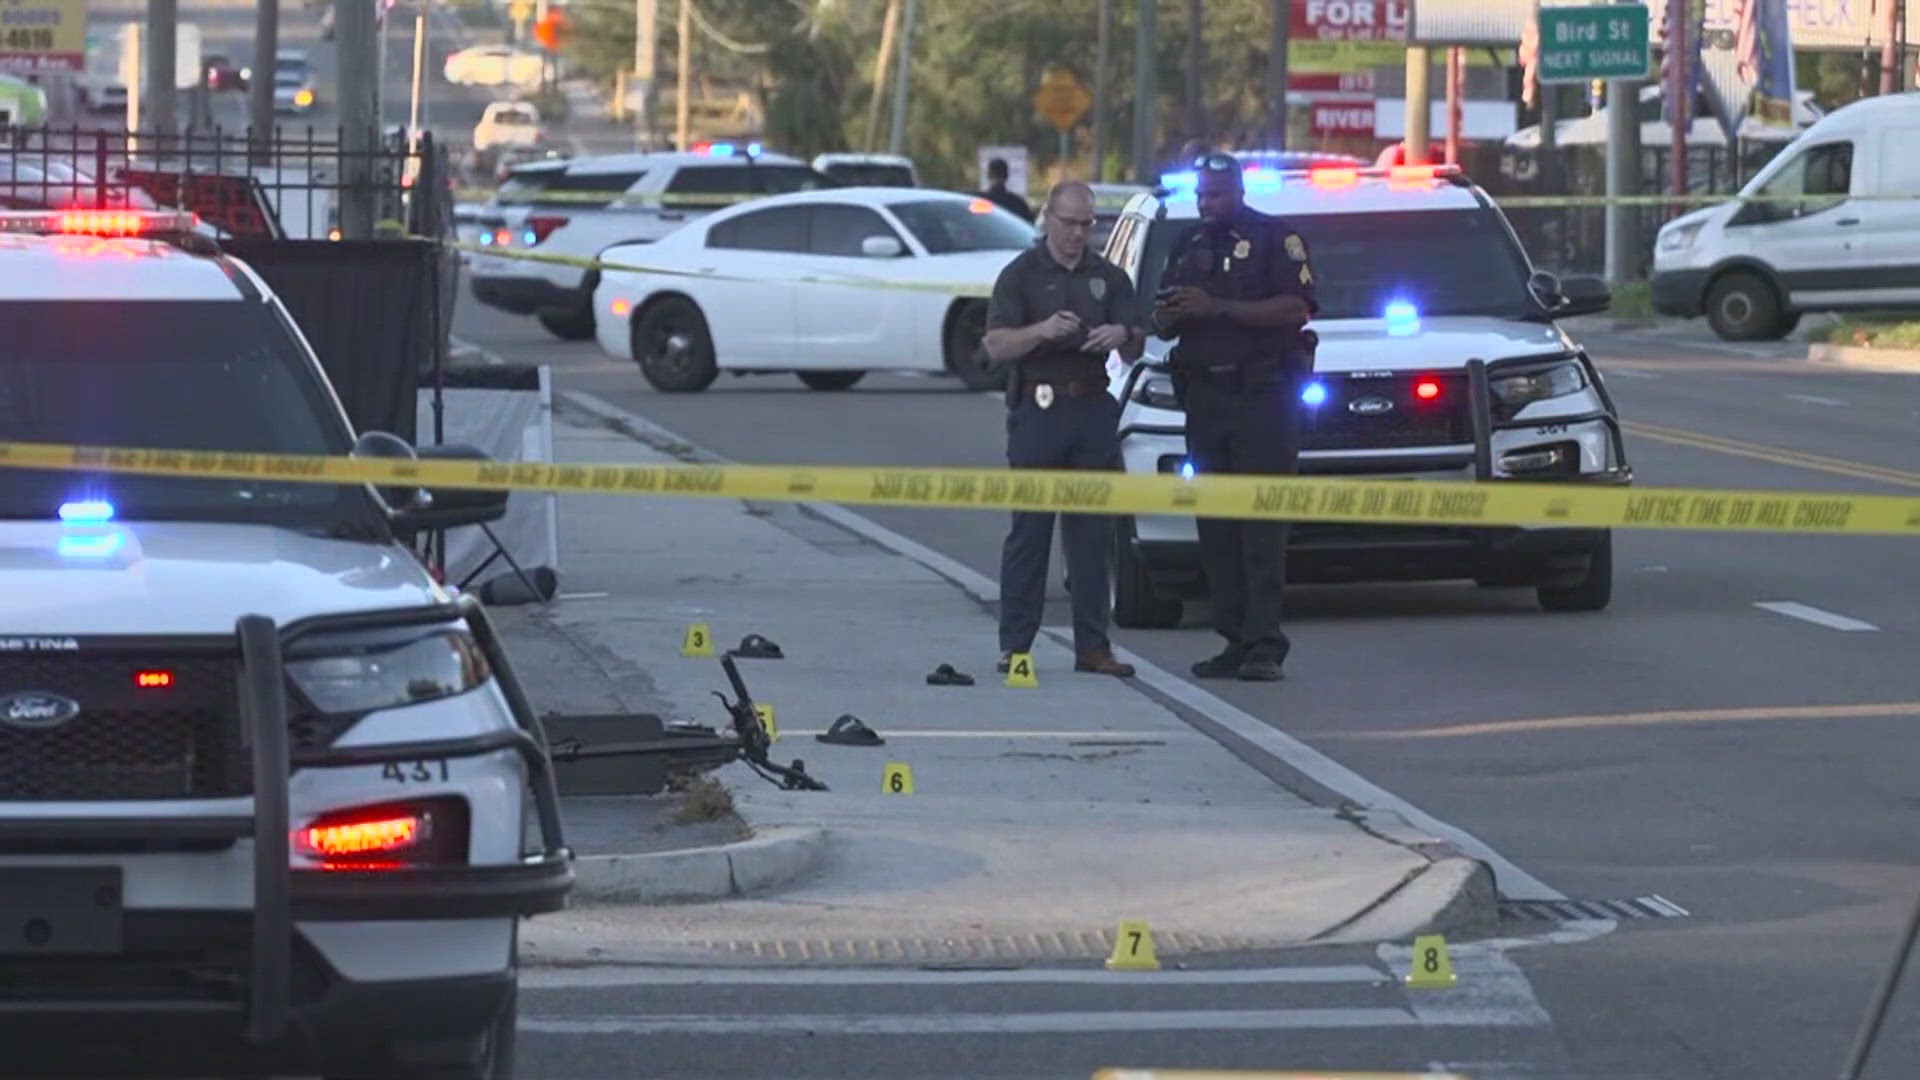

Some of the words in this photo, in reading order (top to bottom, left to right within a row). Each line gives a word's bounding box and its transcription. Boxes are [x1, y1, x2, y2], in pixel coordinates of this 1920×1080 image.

[1305, 0, 1375, 26] FOR
[1385, 0, 1407, 25] L
[0, 29, 53, 49] -4616
[1555, 20, 1597, 42] Bird
[1608, 18, 1631, 41] St
[1543, 50, 1581, 68] NEXT
[1588, 48, 1642, 67] SIGNAL
[1316, 108, 1375, 129] RIVER
[693, 631, 704, 647] 3
[1014, 658, 1030, 678] 4
[890, 771, 904, 793] 6
[1127, 931, 1142, 957] 7
[1424, 946, 1439, 973] 8
